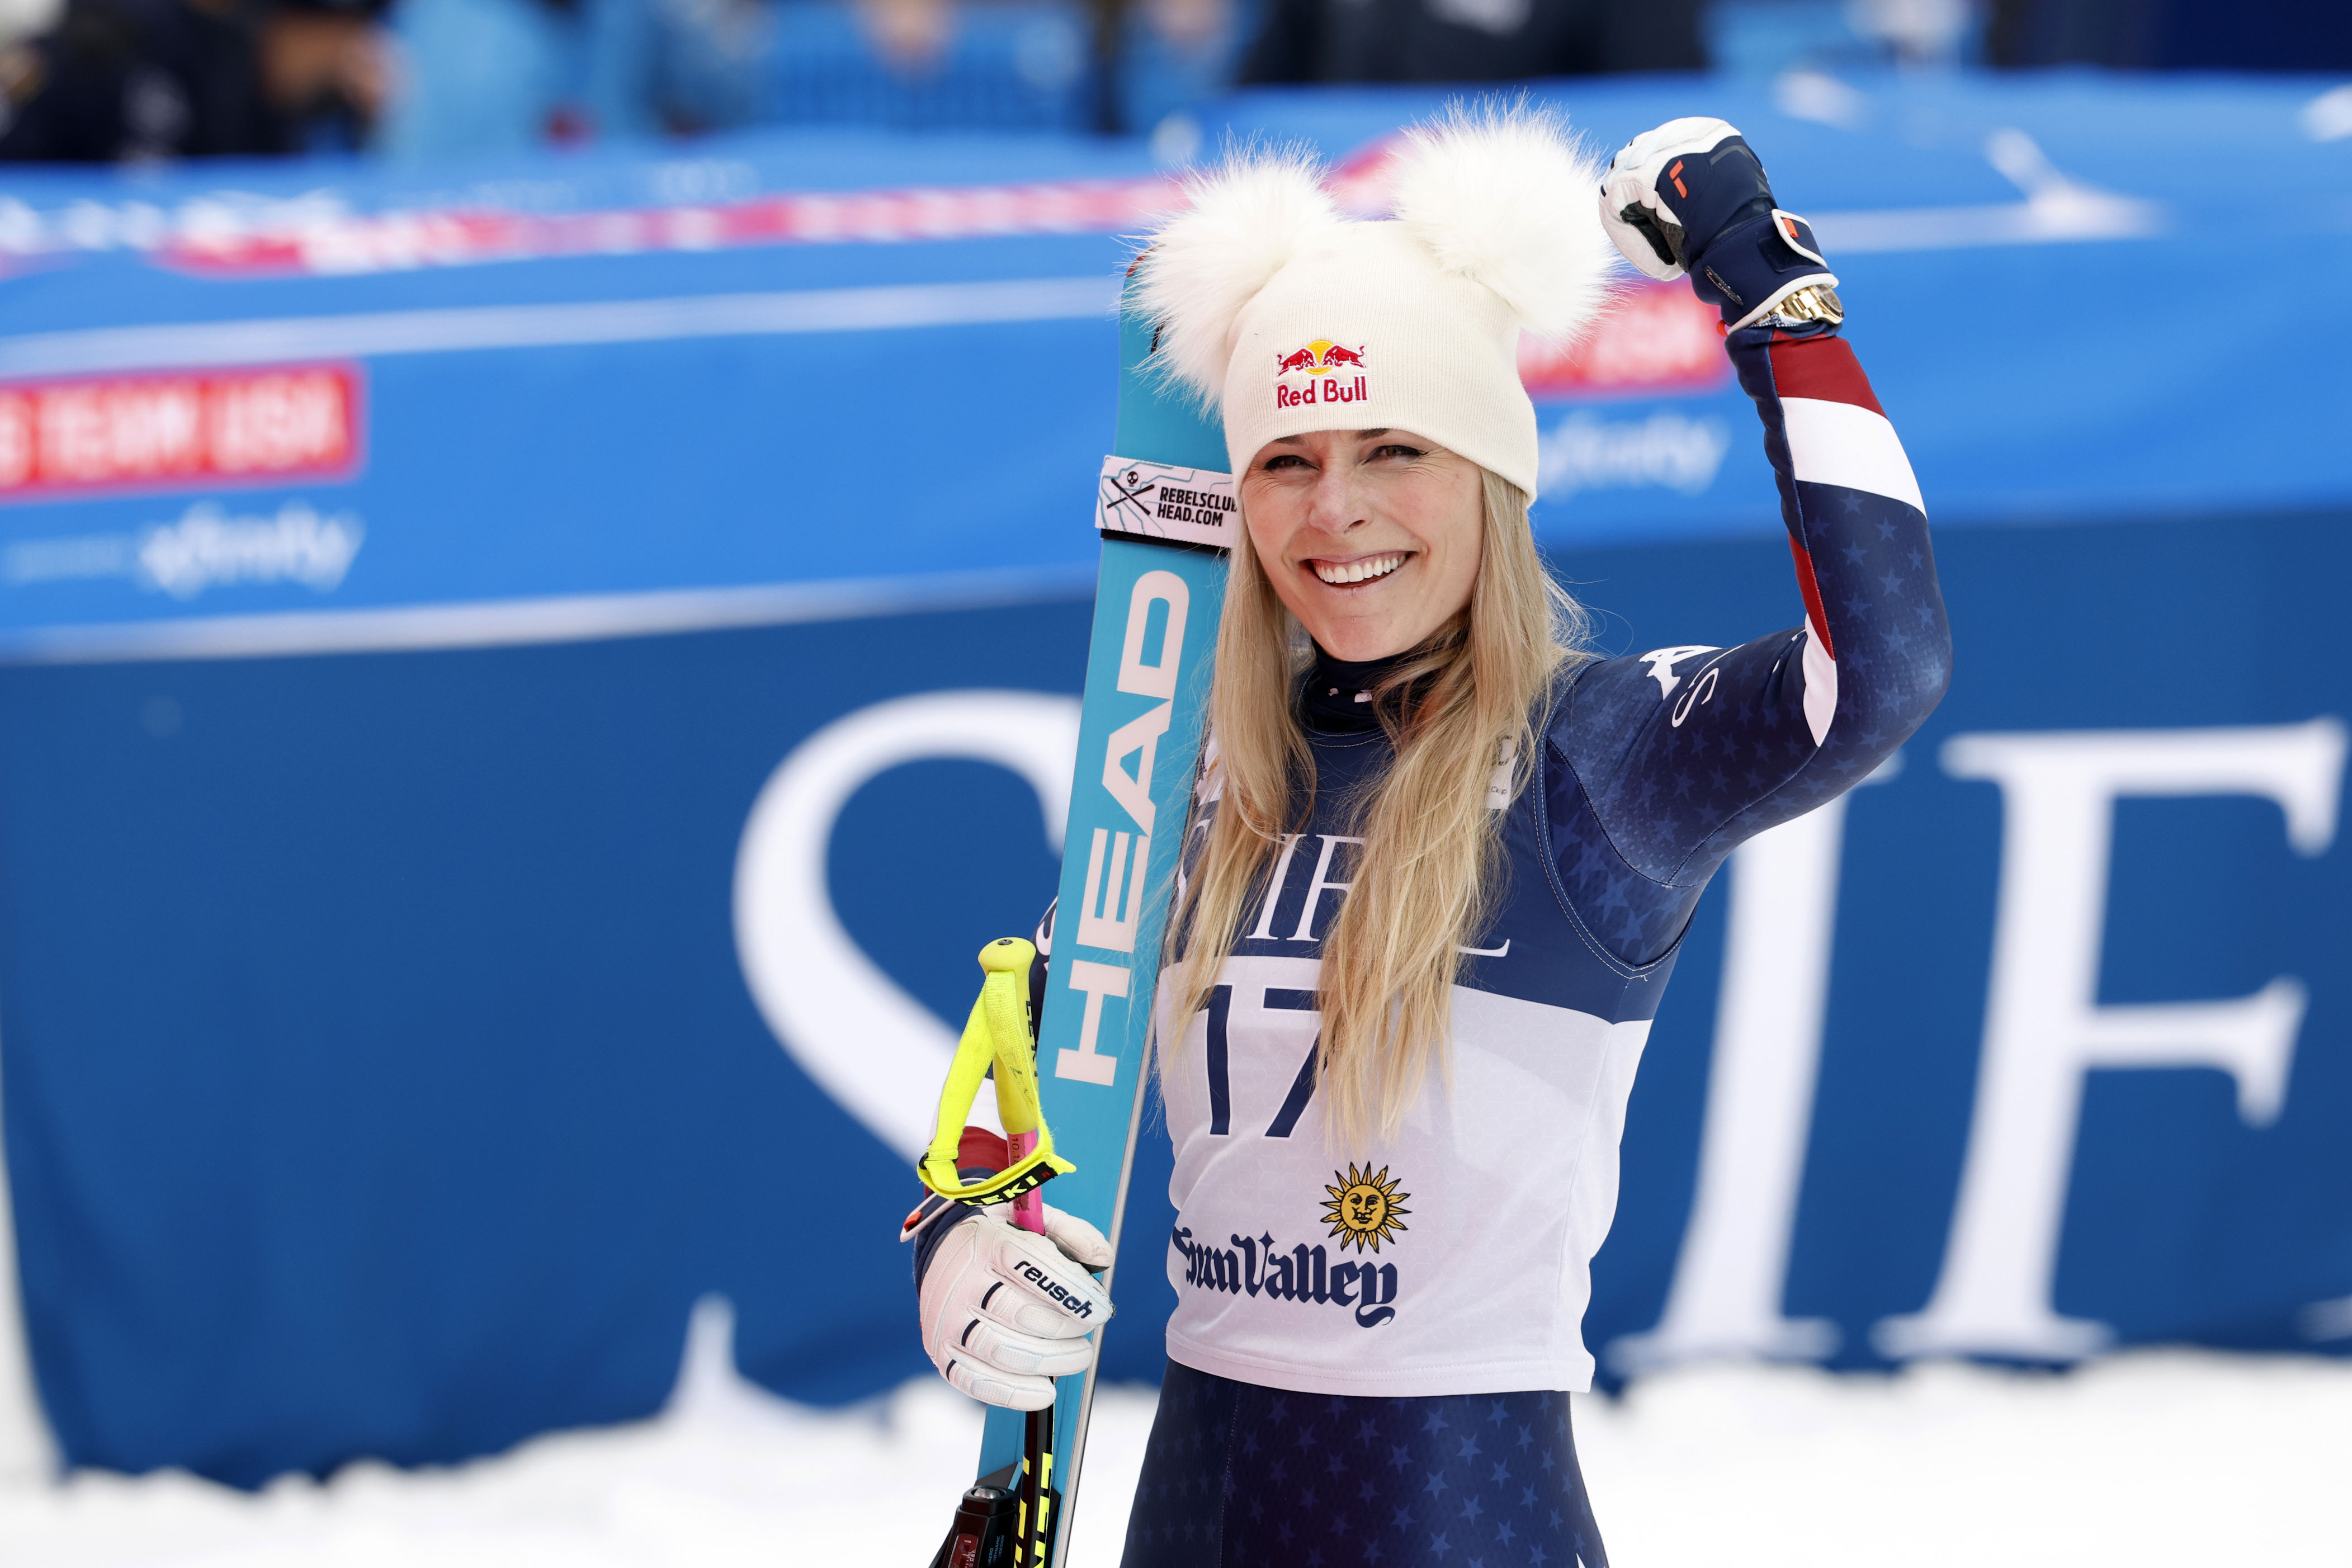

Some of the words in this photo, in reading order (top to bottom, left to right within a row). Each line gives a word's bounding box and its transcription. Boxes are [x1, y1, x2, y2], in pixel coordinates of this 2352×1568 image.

[1278, 379, 1316, 409] Red
[1324, 376, 1367, 402] Bull
[1158, 503, 1223, 527] HEAD.COM
[1055, 570, 1189, 1087] HEAD
[1191, 983, 1330, 1139] 17
[962, 1175, 1038, 1206] LEKI
[1014, 1260, 1092, 1319] reusch
